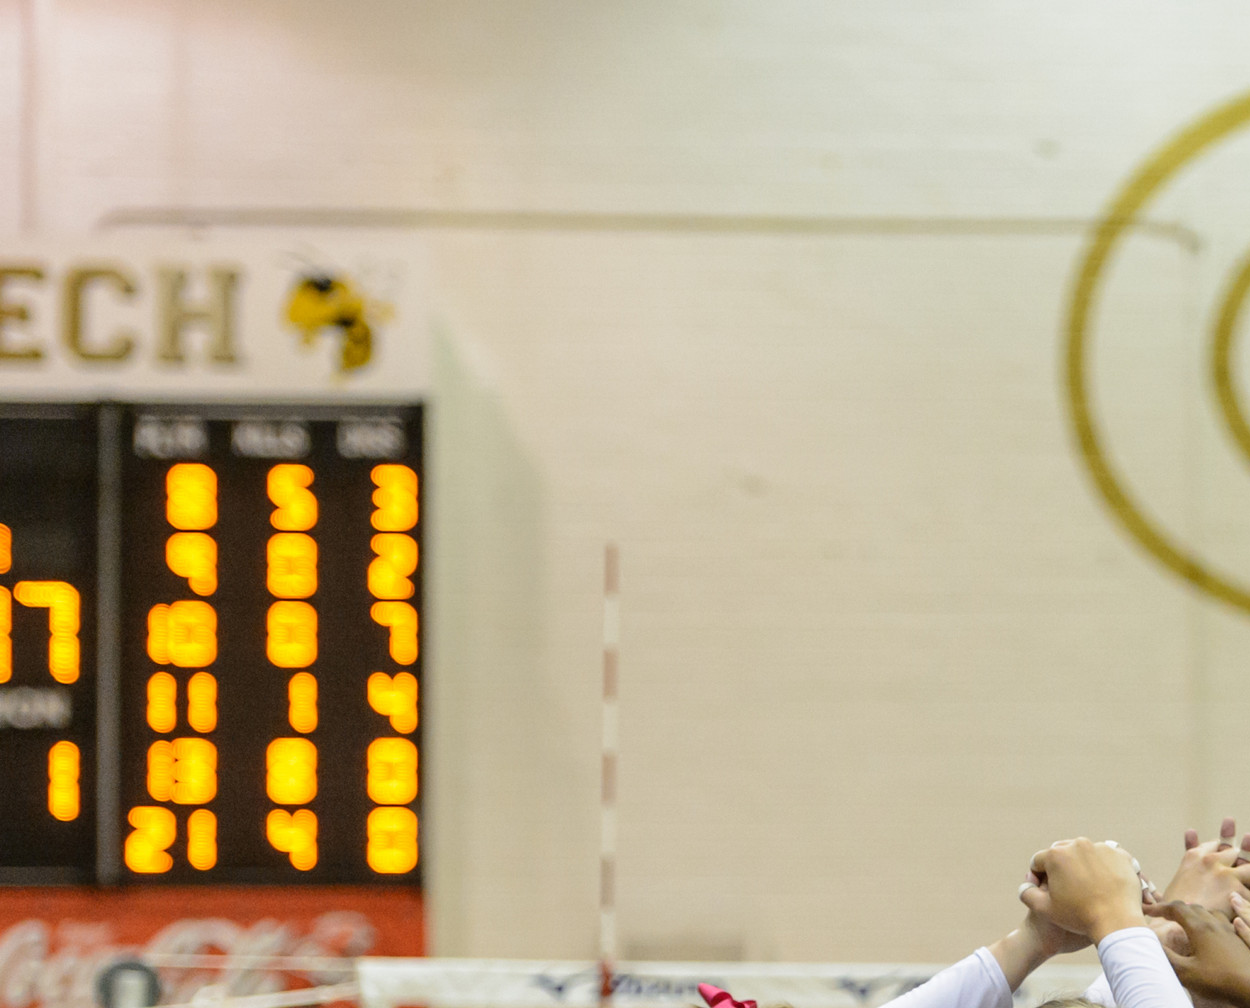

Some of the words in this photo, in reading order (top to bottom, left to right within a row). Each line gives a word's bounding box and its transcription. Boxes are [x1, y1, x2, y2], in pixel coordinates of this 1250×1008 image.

[267, 463, 318, 531] 5
[371, 464, 418, 531] 3
[368, 533, 418, 599] 2
[371, 601, 418, 665] 7
[147, 672, 217, 733] 11
[289, 672, 318, 733] 1
[368, 672, 418, 733] 4
[48, 740, 80, 821] 1
[125, 806, 217, 873] 21
[267, 809, 318, 870] 4
